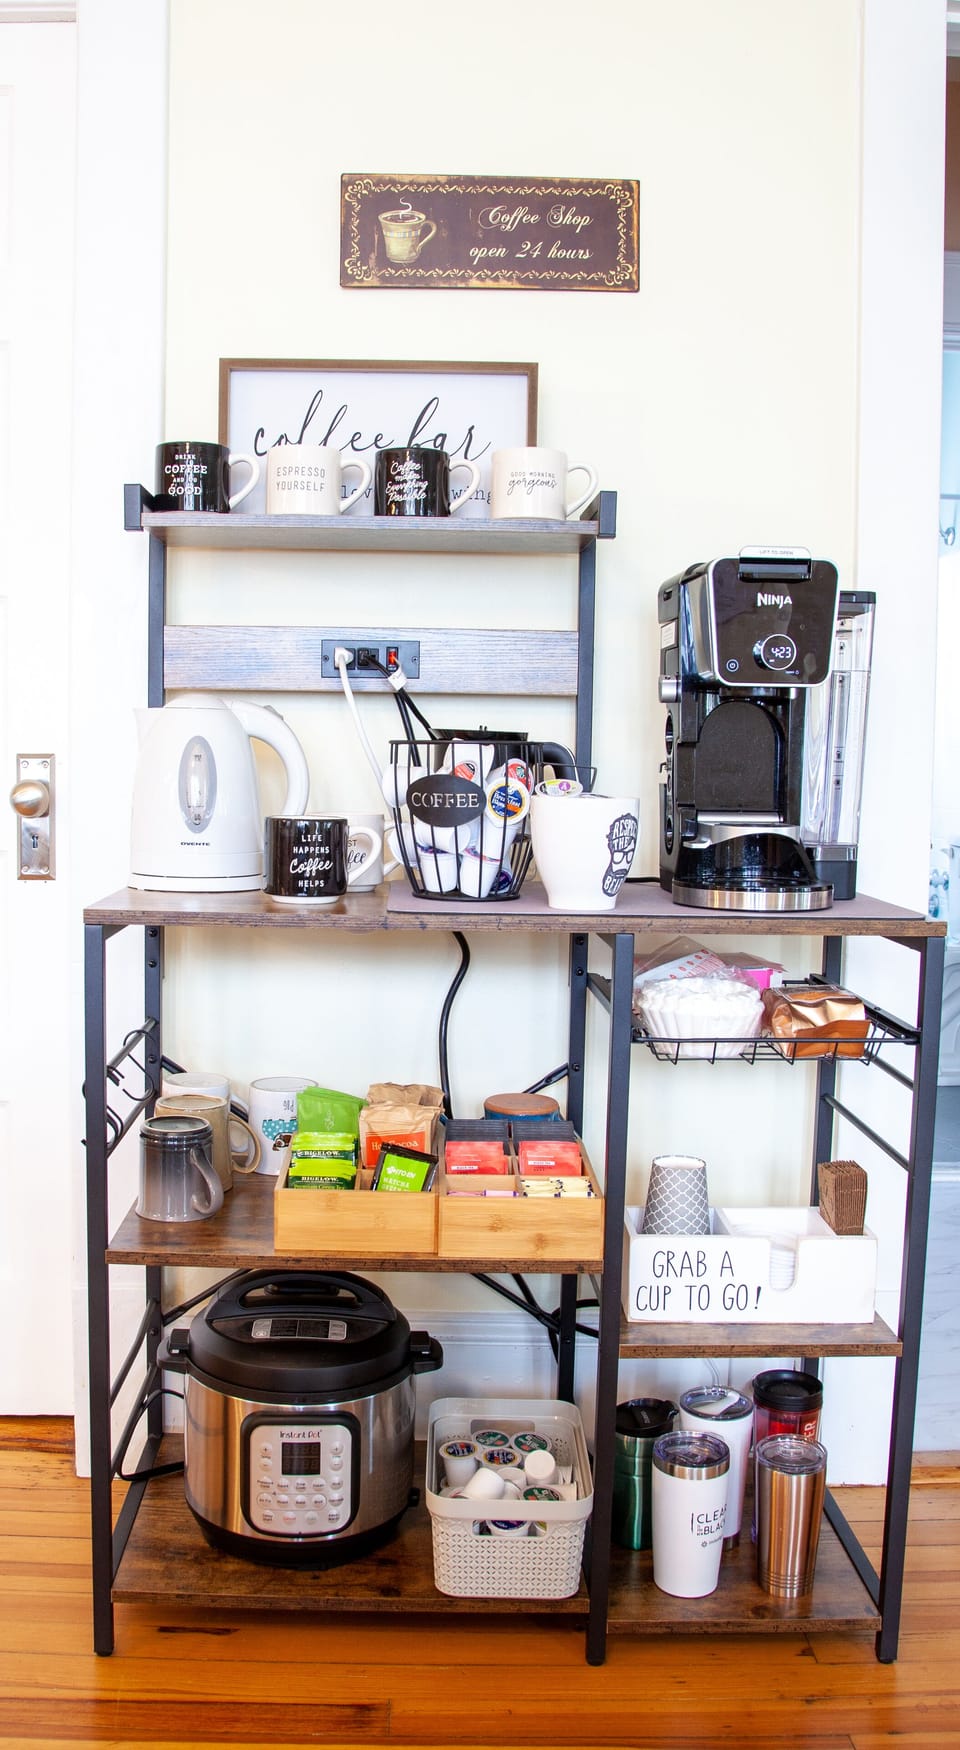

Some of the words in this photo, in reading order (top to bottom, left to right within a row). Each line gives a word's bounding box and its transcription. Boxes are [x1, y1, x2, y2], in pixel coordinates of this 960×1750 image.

[478, 205, 541, 232] Coffee
[546, 204, 593, 233] Shop
[469, 245, 508, 265] open
[515, 240, 541, 258] 24
[547, 240, 593, 260] hours
[406, 396, 492, 461] bar
[164, 464, 208, 474] COFFEE
[276, 465, 326, 478] ESPRESSO
[390, 460, 421, 475] Coffee
[168, 486, 202, 495] GOOD
[276, 481, 325, 492] YOURSELF
[385, 479, 429, 495] Everything
[507, 477, 557, 495] gorgeous
[757, 592, 792, 609] NINJA
[411, 791, 480, 808] COFFEE
[301, 834, 323, 842] LIFE
[347, 839, 357, 848] ST
[293, 846, 330, 854] HAPPENS
[289, 857, 334, 877] Coffee
[298, 880, 325, 888] HELPS
[371, 1141, 382, 1151] Ho
[652, 1250, 707, 1278] GRAB
[720, 1250, 735, 1278] A
[636, 1285, 671, 1312] CUP
[685, 1284, 710, 1311] TO
[279, 1430, 306, 1439] Instant
[308, 1430, 321, 1439] Pot
